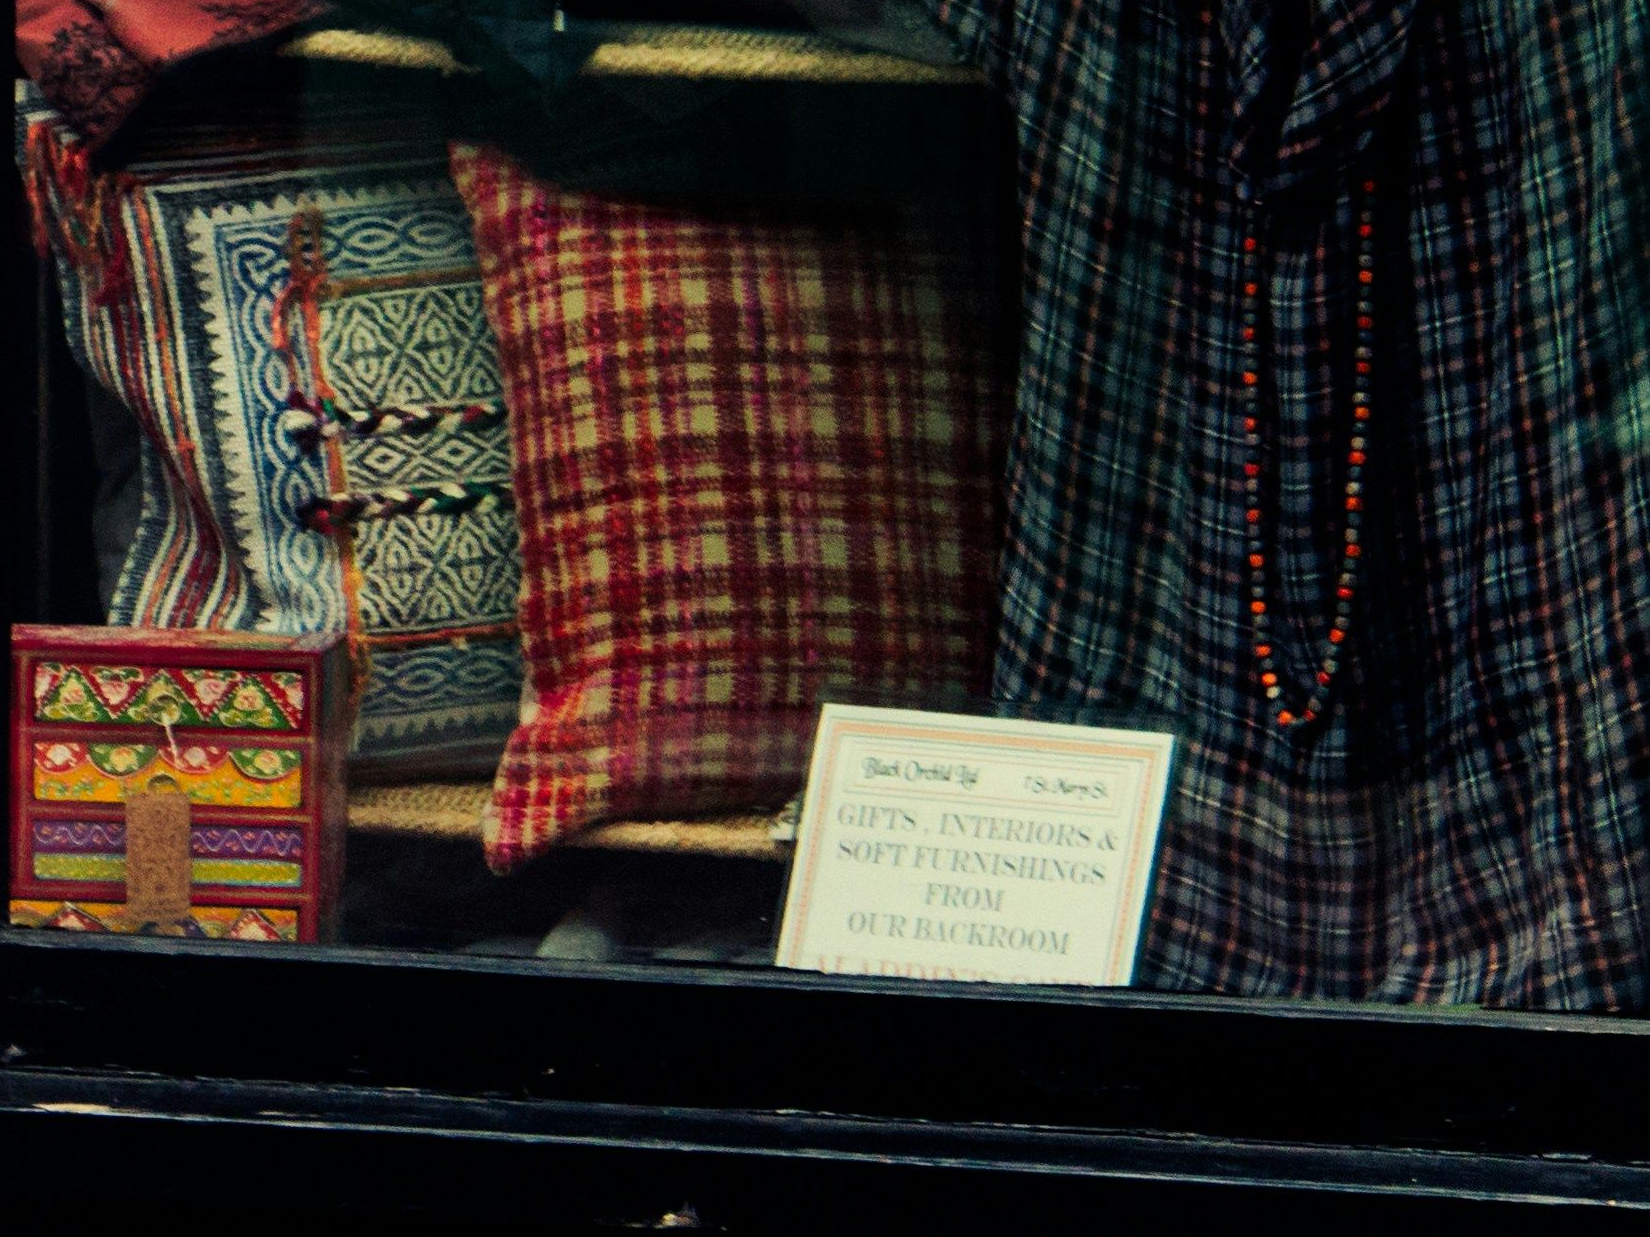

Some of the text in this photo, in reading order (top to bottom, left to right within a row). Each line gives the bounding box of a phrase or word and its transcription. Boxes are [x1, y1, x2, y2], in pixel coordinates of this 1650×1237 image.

[837, 803, 917, 831] GIFTS
[937, 812, 1093, 848] INTERIORS
[1097, 827, 1118, 852] &
[835, 839, 1107, 885] SOFT FURNISHINGS
[923, 882, 1005, 913] FROM
[847, 911, 1070, 956] OUR BACKROOM
